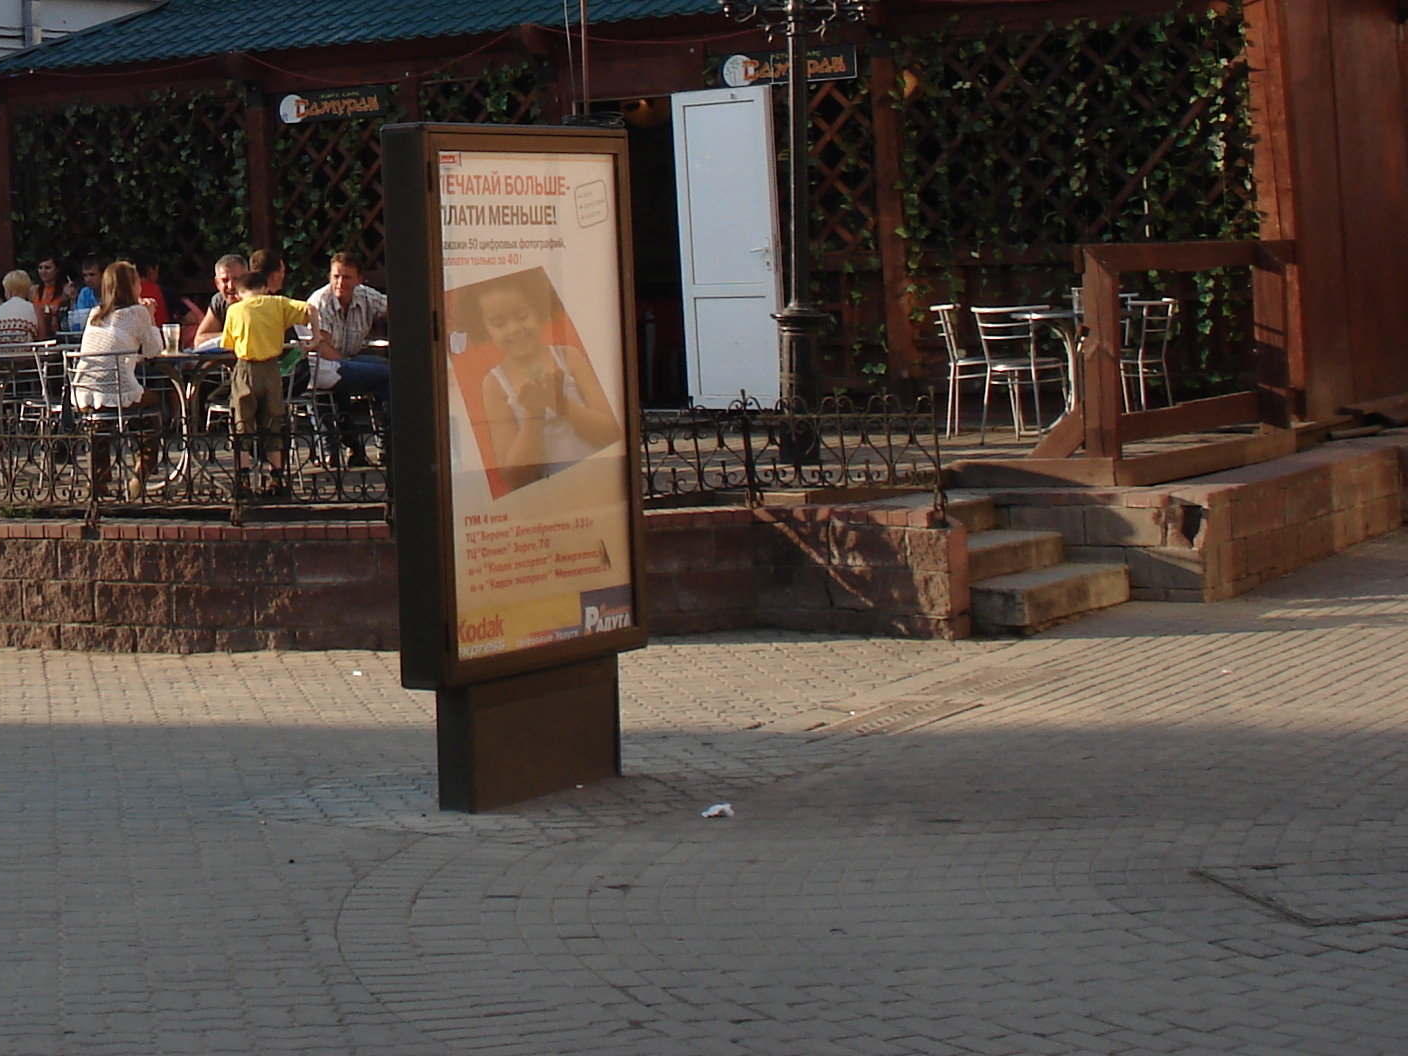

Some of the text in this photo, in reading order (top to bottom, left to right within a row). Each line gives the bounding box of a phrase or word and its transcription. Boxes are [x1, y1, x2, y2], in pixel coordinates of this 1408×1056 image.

[488, 205, 557, 226] МЕНЬШЕ!
[443, 240, 467, 250] акажи
[468, 238, 478, 250] 50
